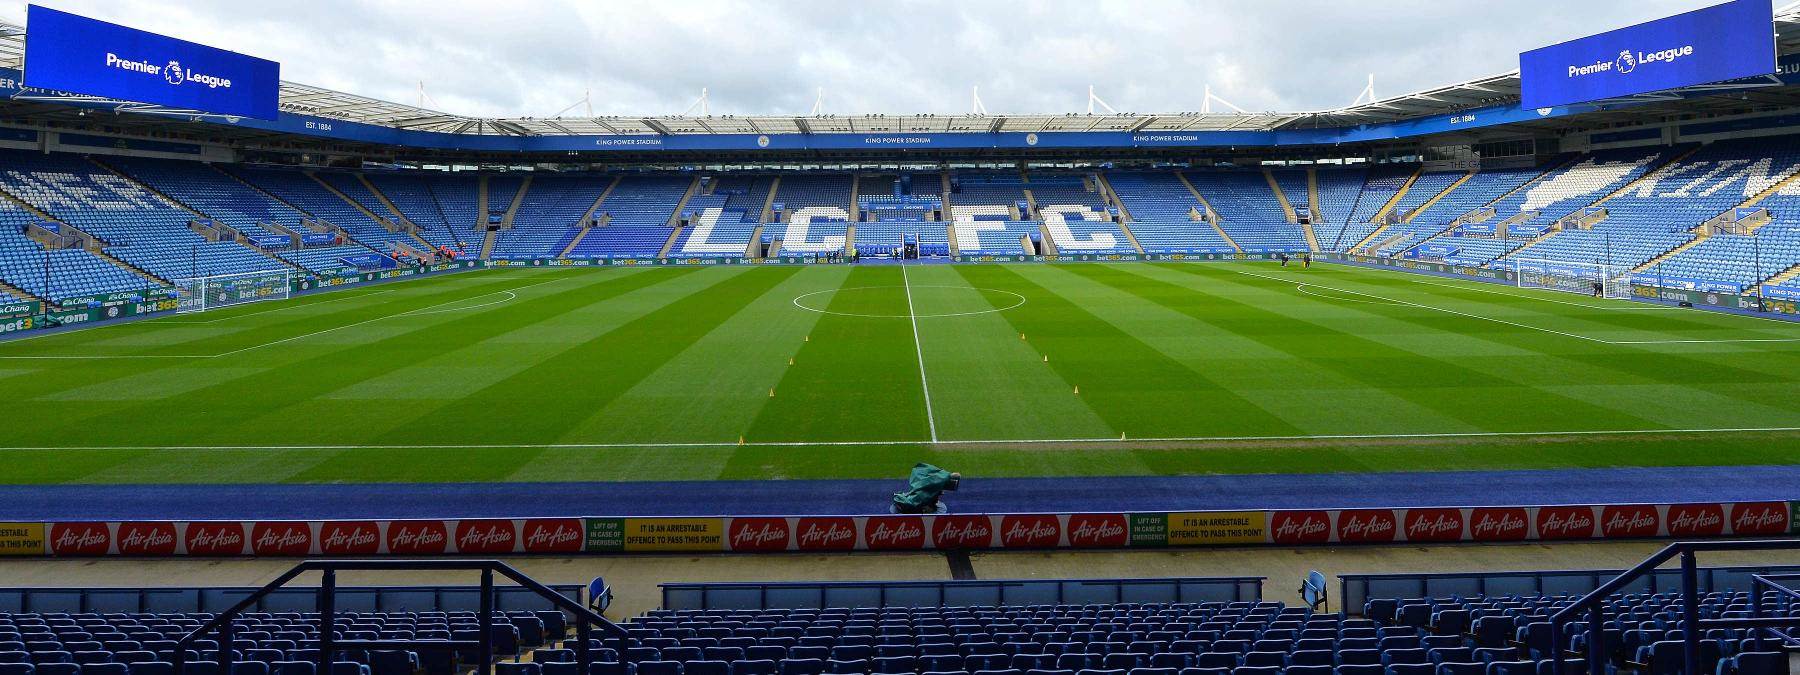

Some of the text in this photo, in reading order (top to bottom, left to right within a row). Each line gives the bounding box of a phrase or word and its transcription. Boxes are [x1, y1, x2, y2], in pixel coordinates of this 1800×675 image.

[1568, 44, 1694, 78] Premier League
[106, 52, 232, 89] Premier League
[1450, 113, 1476, 125] EST. 1884
[305, 121, 332, 132] EST. 1884
[1395, 260, 1431, 271] bet365.com
[380, 269, 414, 279] bet365.com
[1452, 267, 1496, 278] bet365.com
[318, 276, 360, 288] bet365.com
[1662, 278, 1674, 286] KING
[1701, 281, 1737, 291] KING POWER
[239, 286, 292, 299] bet365.com
[73, 296, 95, 305] Chang
[4, 303, 30, 314] Chang
[1209, 518, 1249, 526] ARRESTABLE
[640, 524, 707, 532] IT IS AN ARRESTABLE
[1170, 530, 1199, 538] OFFENCE
[1210, 529, 1226, 537] PASS
[1227, 529, 1242, 537] THIS
[1243, 528, 1262, 536] POINT
[7, 540, 21, 548] THIS
[22, 540, 42, 548] POINT
[626, 535, 721, 544] OFFENCE TO PASS THIS POINT
